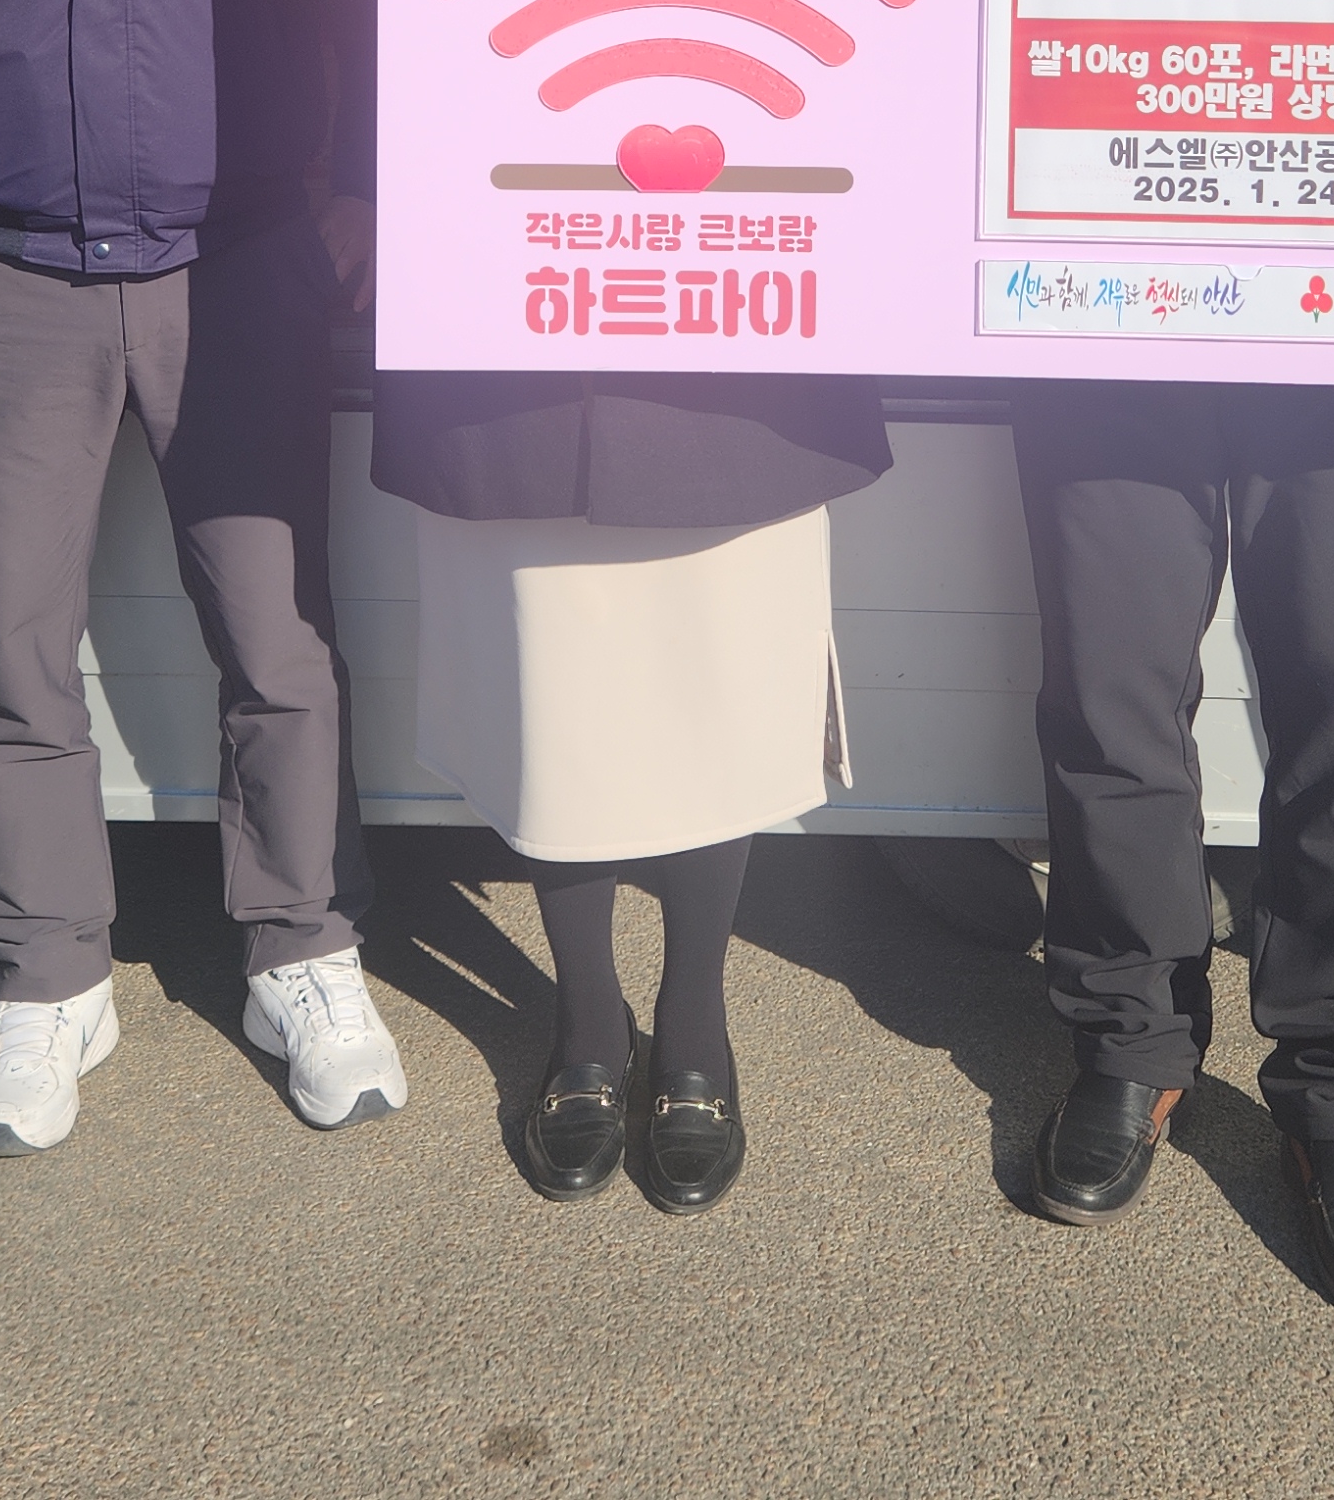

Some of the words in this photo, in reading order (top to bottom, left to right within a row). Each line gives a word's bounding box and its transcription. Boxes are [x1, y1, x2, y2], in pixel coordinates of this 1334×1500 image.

[1027, 40, 1150, 79] 쌀10kg
[1161, 43, 1254, 81] 60포,
[1136, 82, 1274, 119] 300만원
[1133, 176, 1231, 207] 2025.
[1250, 178, 1280, 208] 1.
[525, 212, 686, 252] 작은사랑
[697, 213, 817, 253] 큰보람
[525, 266, 817, 339] 하트파이
[1007, 261, 1055, 322] 시민과
[1055, 265, 1090, 311] 함께,
[1094, 274, 1141, 327] 자유로운
[1145, 277, 1197, 326] 혁신도시
[1203, 275, 1246, 316] 안산
